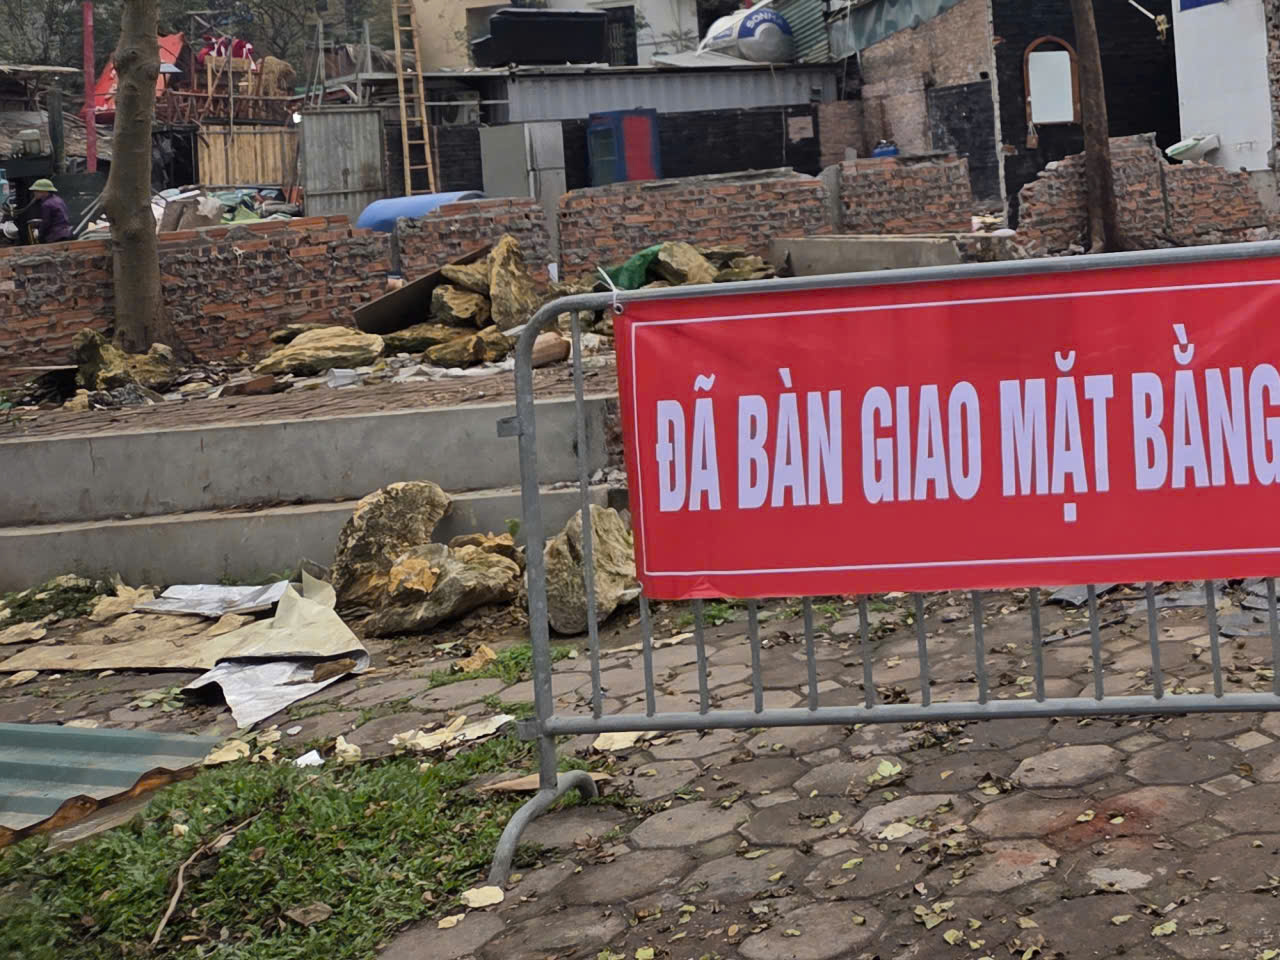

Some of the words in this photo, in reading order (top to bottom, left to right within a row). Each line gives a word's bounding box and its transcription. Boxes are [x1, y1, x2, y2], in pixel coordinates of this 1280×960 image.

[656, 374, 721, 512] ĐÃ
[738, 368, 843, 509] BÀN
[862, 381, 981, 503] GIAO
[1000, 351, 1113, 522] MẶT
